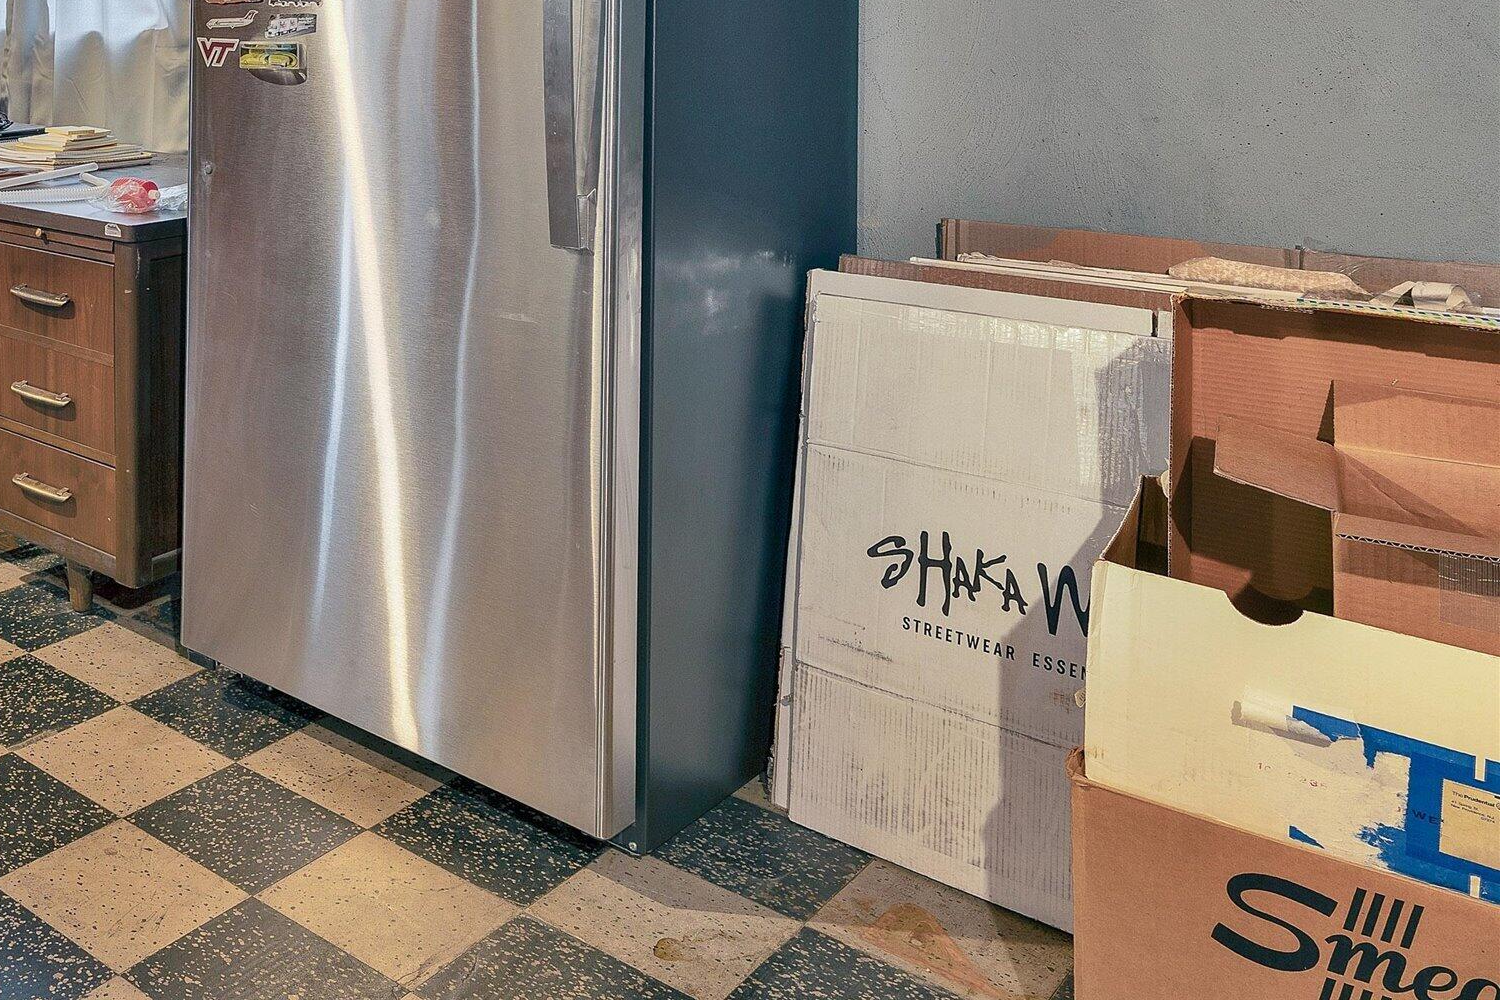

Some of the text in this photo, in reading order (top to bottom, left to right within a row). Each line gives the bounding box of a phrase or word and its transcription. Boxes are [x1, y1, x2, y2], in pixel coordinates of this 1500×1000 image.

[198, 38, 238, 67] VT
[866, 530, 1029, 617] SHAKA
[902, 616, 1016, 661] STREETWEAR
[1452, 791, 1495, 807] The Prudential
